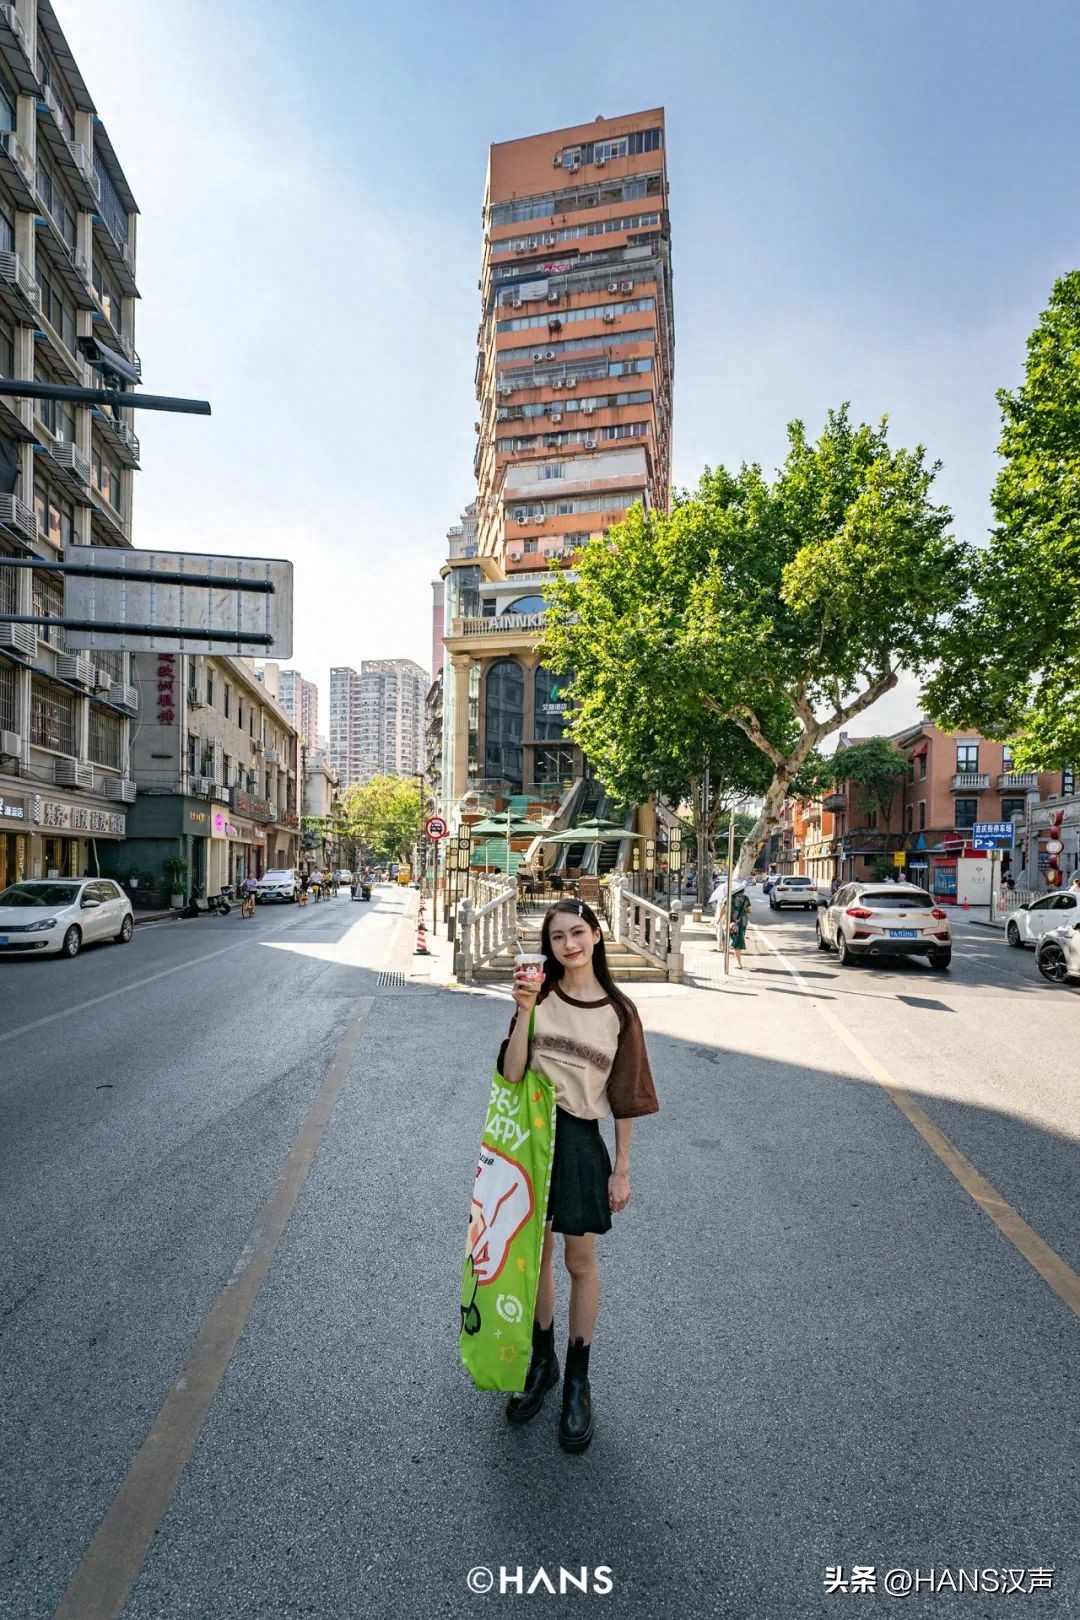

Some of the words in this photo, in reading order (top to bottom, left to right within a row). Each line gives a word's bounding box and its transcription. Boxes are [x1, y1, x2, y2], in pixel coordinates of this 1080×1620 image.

[975, 824, 1012, 832] 吉庆街停车场
[484, 1108, 531, 1152] APPY
